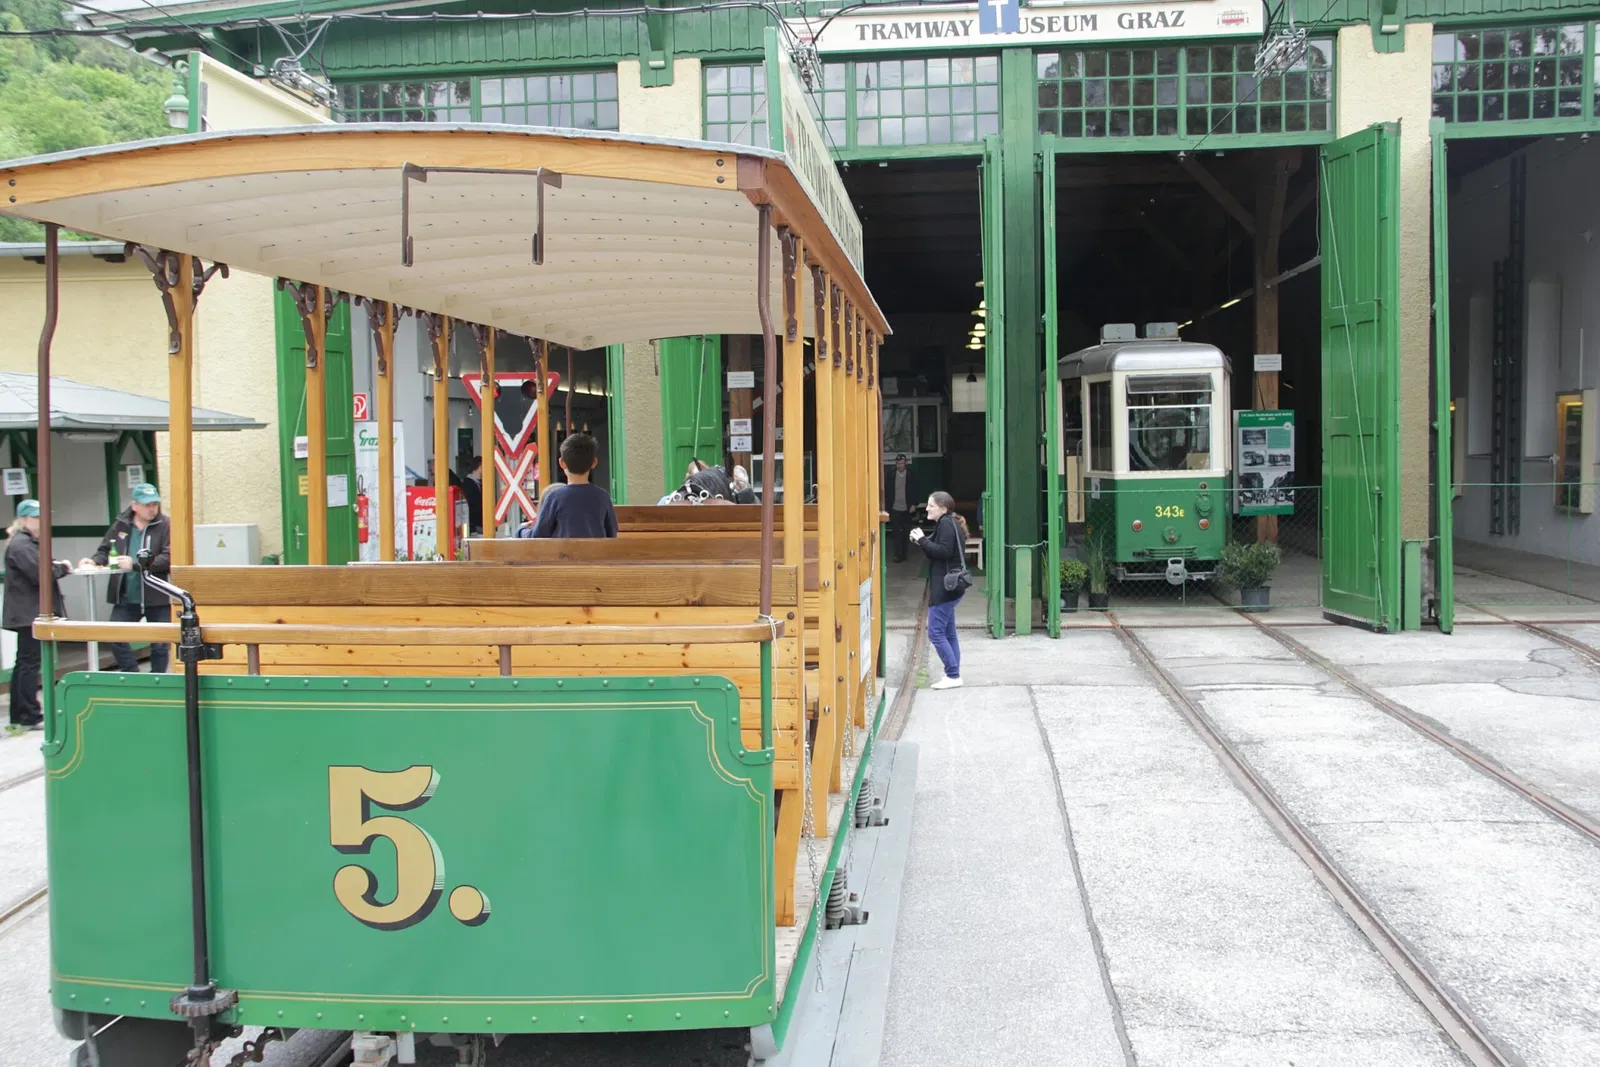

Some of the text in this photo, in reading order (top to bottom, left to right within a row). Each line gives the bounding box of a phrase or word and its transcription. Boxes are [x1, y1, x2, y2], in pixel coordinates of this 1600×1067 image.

[855, 10, 1186, 41] TRAMWAY USEUM GRAZ
[328, 765, 491, 931] 5.
